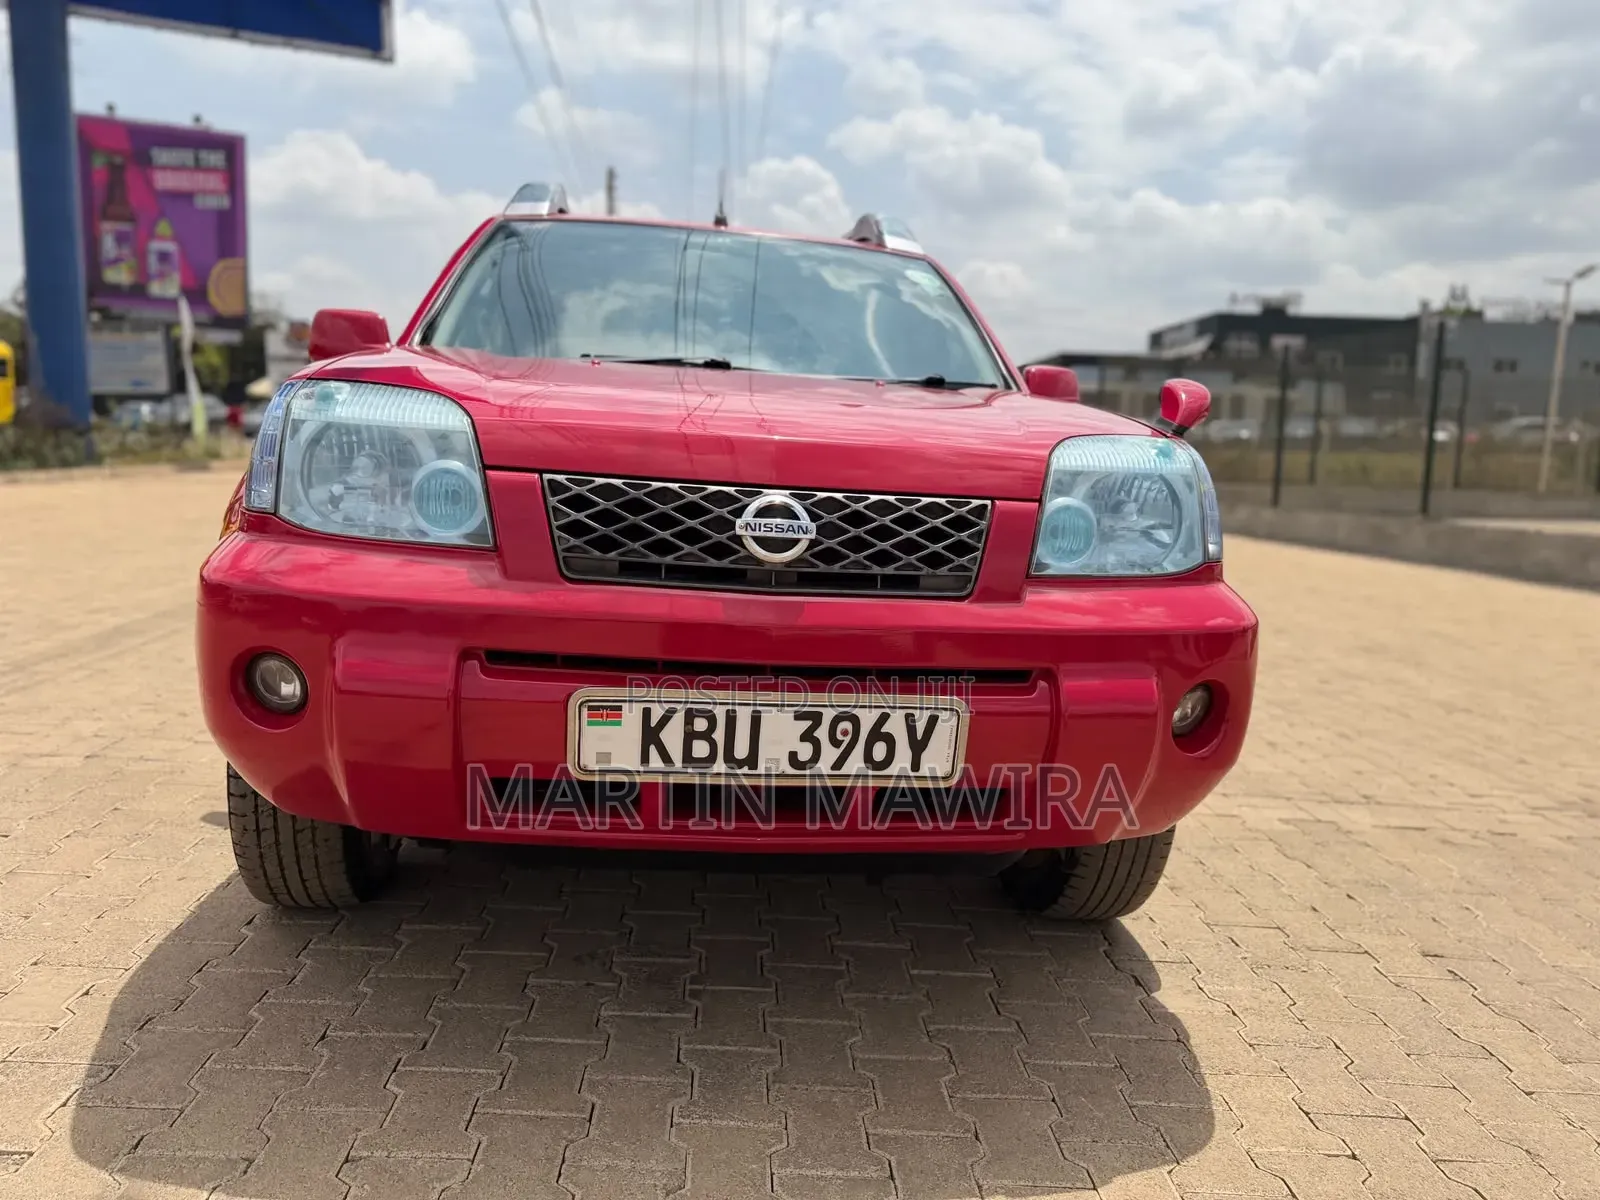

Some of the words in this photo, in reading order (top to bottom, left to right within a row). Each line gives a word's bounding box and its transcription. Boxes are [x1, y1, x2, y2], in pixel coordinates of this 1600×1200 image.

[745, 522, 808, 534] NISSAN
[640, 706, 762, 770] KBU
[788, 710, 940, 772] 396Y
